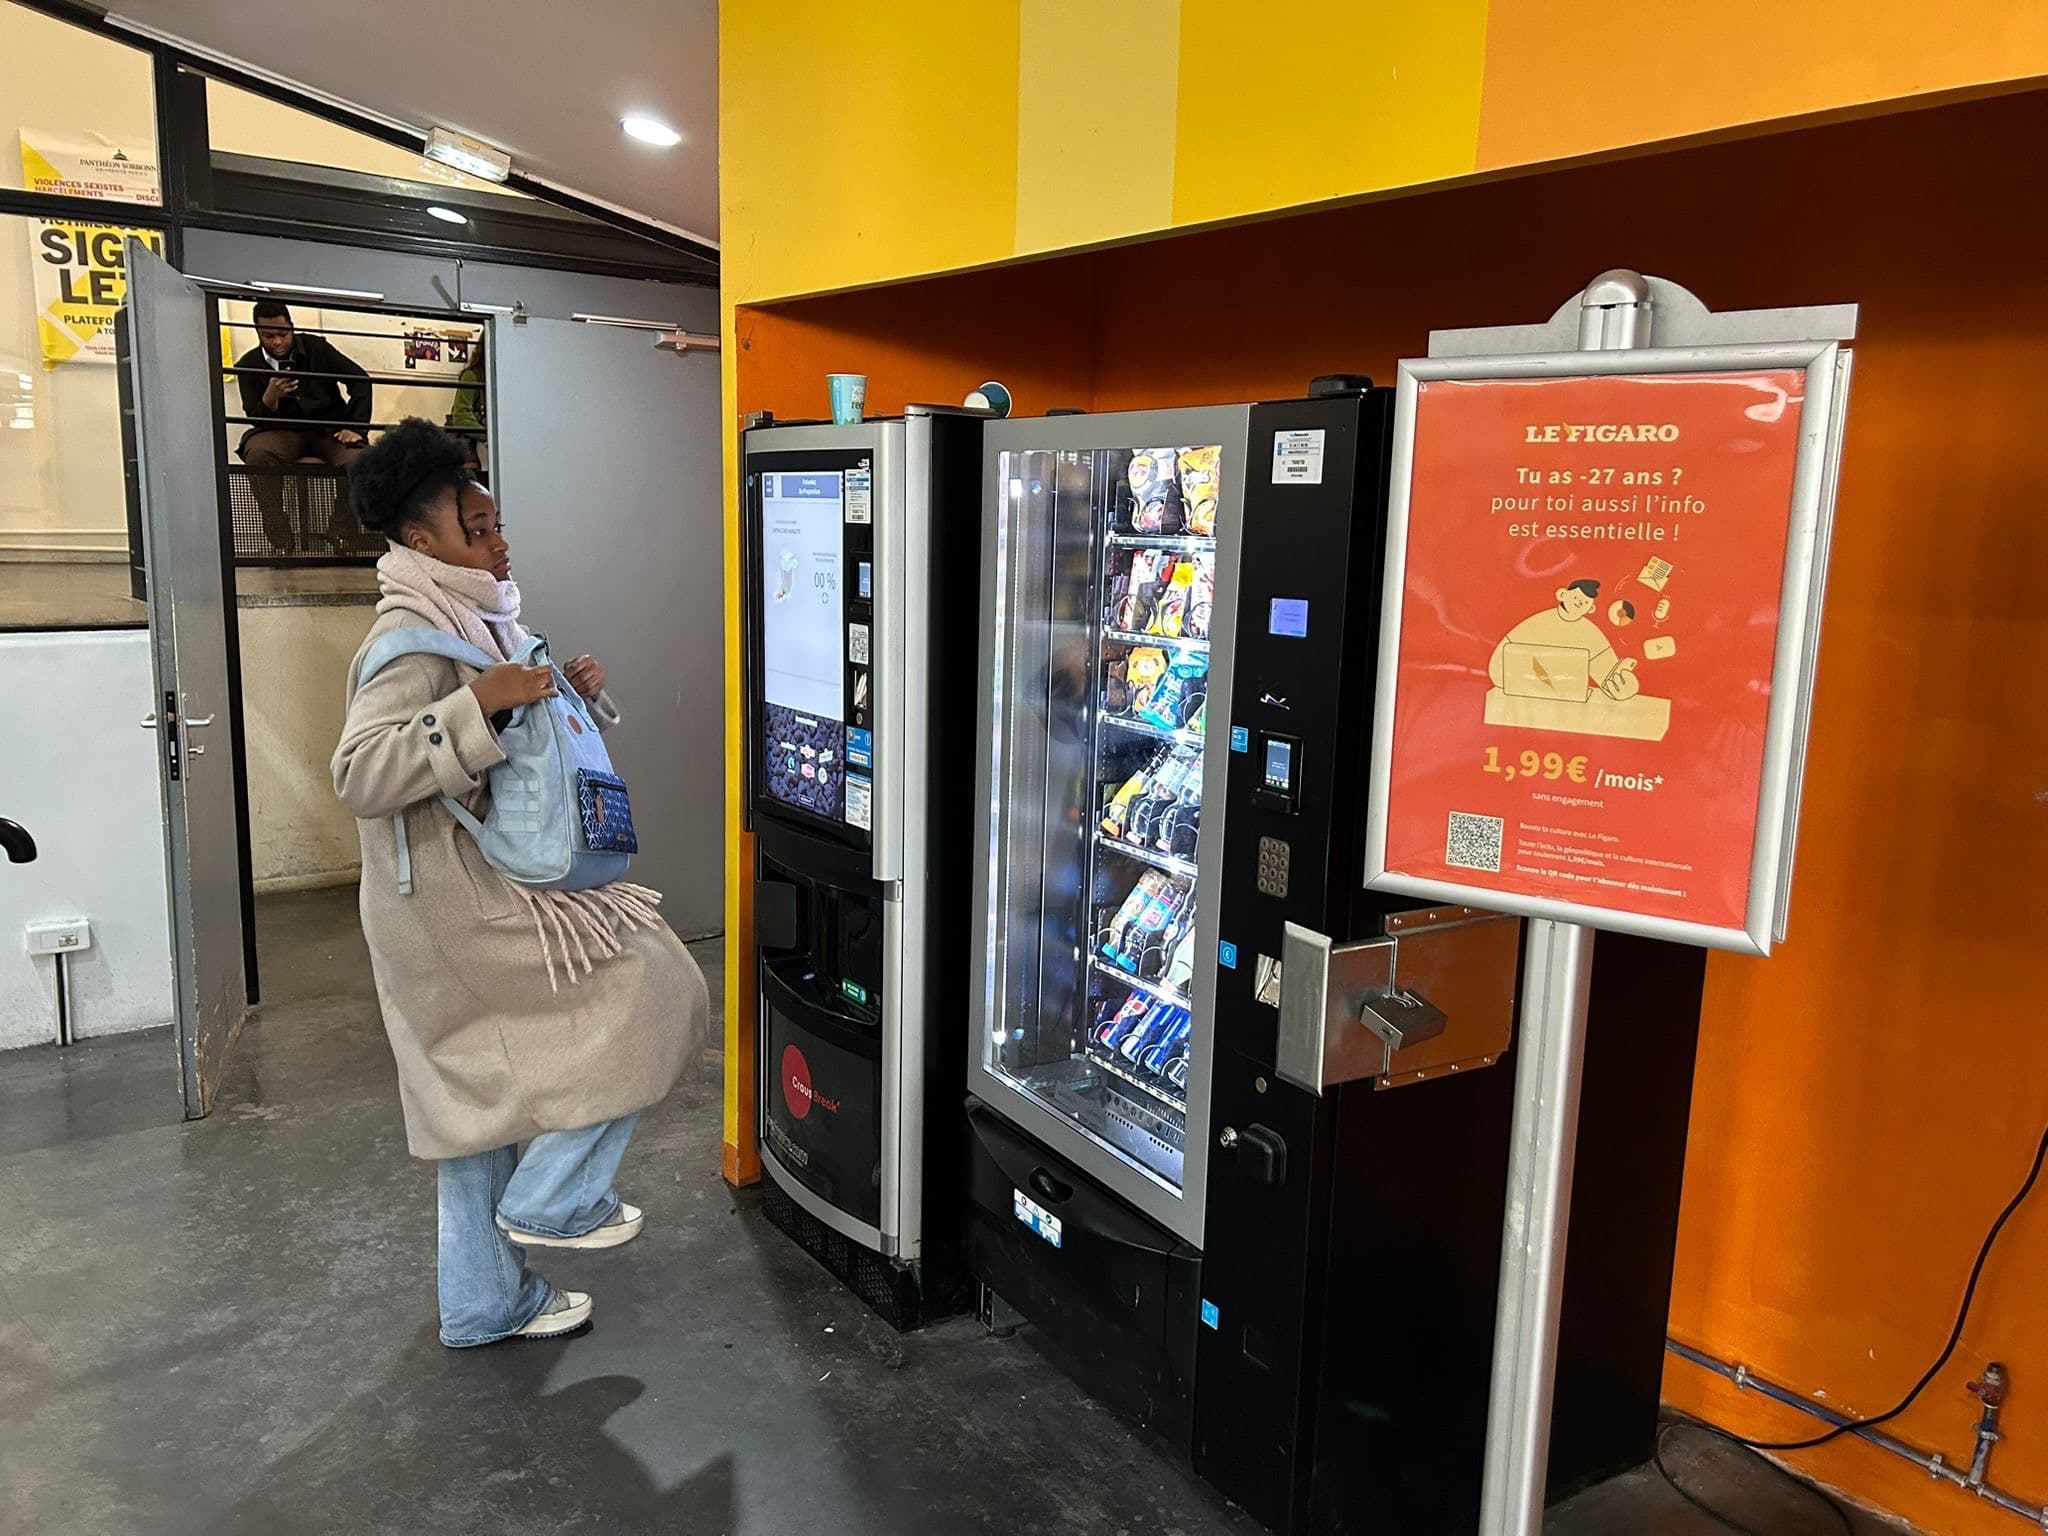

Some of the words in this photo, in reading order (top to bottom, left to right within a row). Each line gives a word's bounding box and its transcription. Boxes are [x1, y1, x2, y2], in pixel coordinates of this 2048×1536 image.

[34, 177, 82, 188] VIOLENCES
[84, 181, 124, 192] SEXISTES
[60, 269, 127, 306] LE
[1525, 424, 1561, 443] LE
[1566, 424, 1680, 443] FIGARO
[1516, 468, 1541, 485] Tu
[1549, 472, 1572, 485] as
[1580, 468, 1615, 485] -27
[1623, 471, 1663, 486] ans
[1672, 468, 1682, 485] ?
[1491, 495, 1539, 515] pour
[1547, 495, 1574, 512] toi
[1582, 495, 1638, 513] aussi
[1508, 523, 1539, 538] est
[1546, 523, 1666, 542] essentielle
[1673, 525, 1679, 542] !
[1482, 746, 1589, 784] 1,99€
[1532, 793, 1551, 802] sans
[1552, 794, 1604, 809] engagement
[1549, 826, 1572, 835] culture
[1588, 831, 1597, 840] Le
[1597, 833, 1620, 843] Figaro.
[1517, 849, 1532, 857] pour
[1533, 851, 1567, 860] seulement
[1519, 839, 1537, 848] Toute
[1619, 854, 1643, 863] culture
[1516, 864, 1540, 874] Scanne
[1547, 869, 1558, 878] QR
[1559, 871, 1575, 879] code
[1575, 874, 1592, 882] pour
[1627, 881, 1639, 889] dès
[1640, 885, 1682, 896] maintenant
[791, 1075, 813, 1099] Crous
